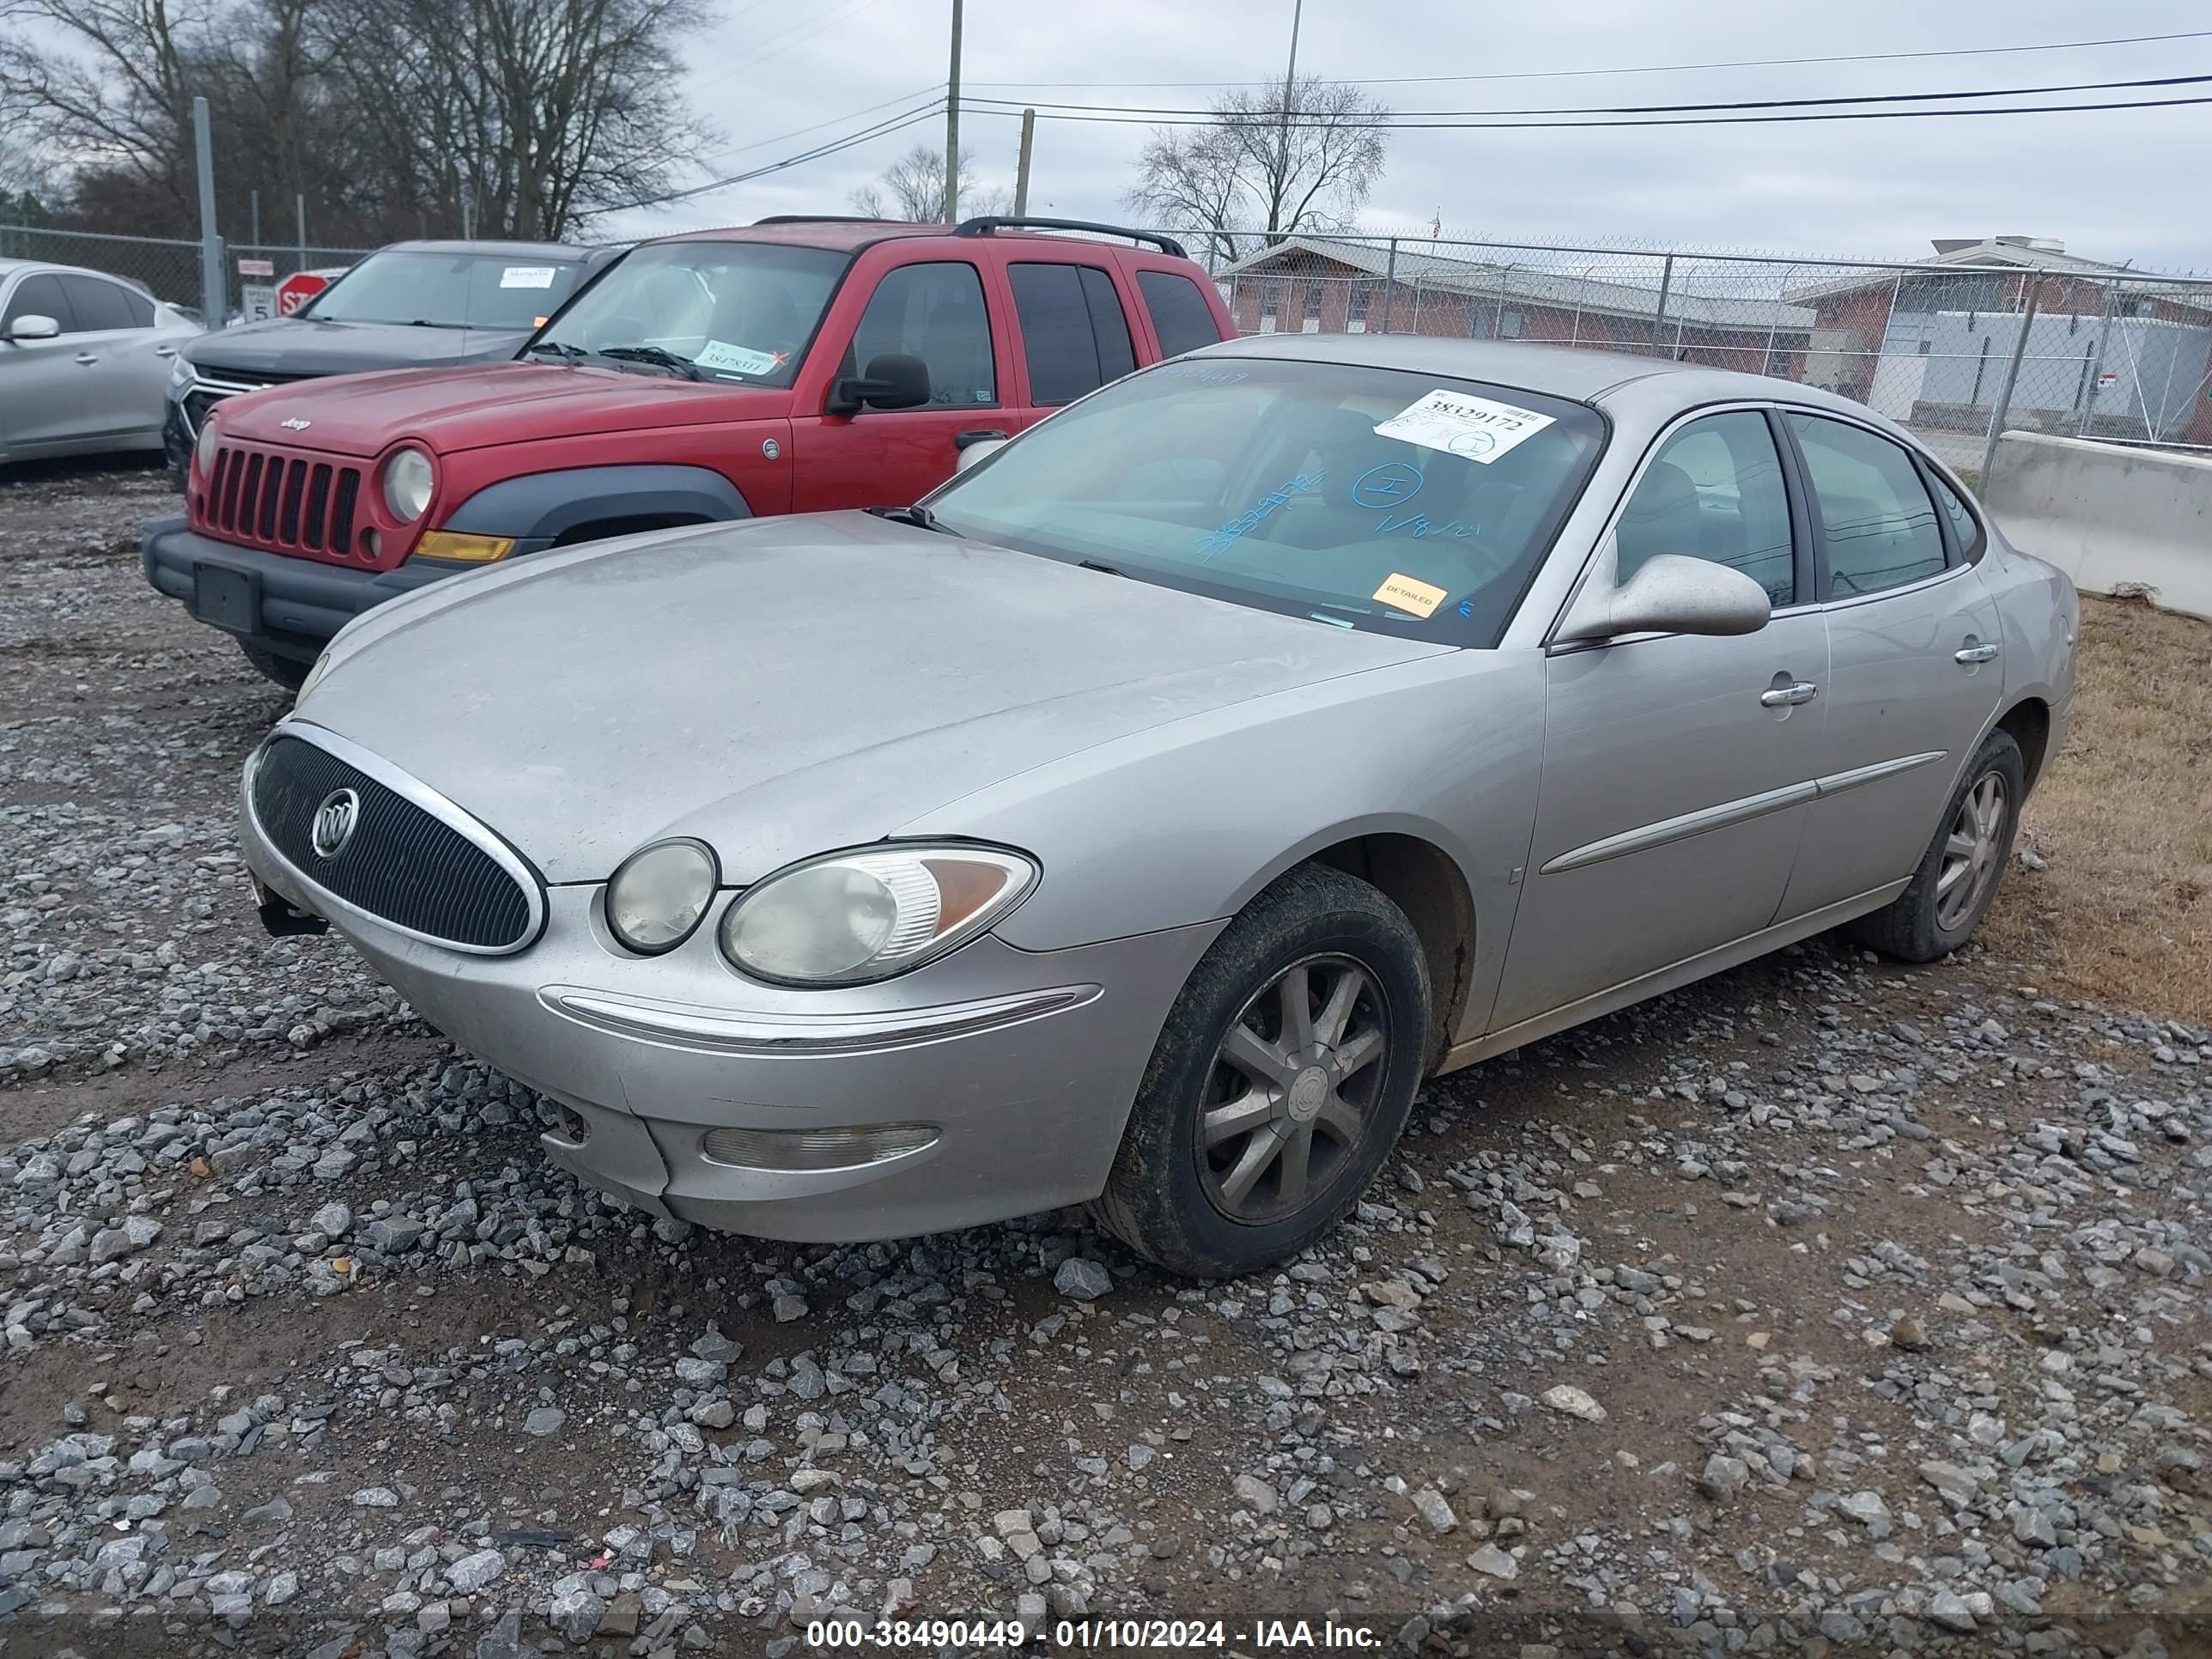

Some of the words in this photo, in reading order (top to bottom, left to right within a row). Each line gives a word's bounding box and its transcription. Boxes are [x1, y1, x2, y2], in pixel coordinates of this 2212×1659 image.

[254, 307, 268, 320] 5
[283, 292, 314, 315] ST
[1424, 400, 1524, 431] 38329172
[1385, 584, 1433, 606] DETAILED
